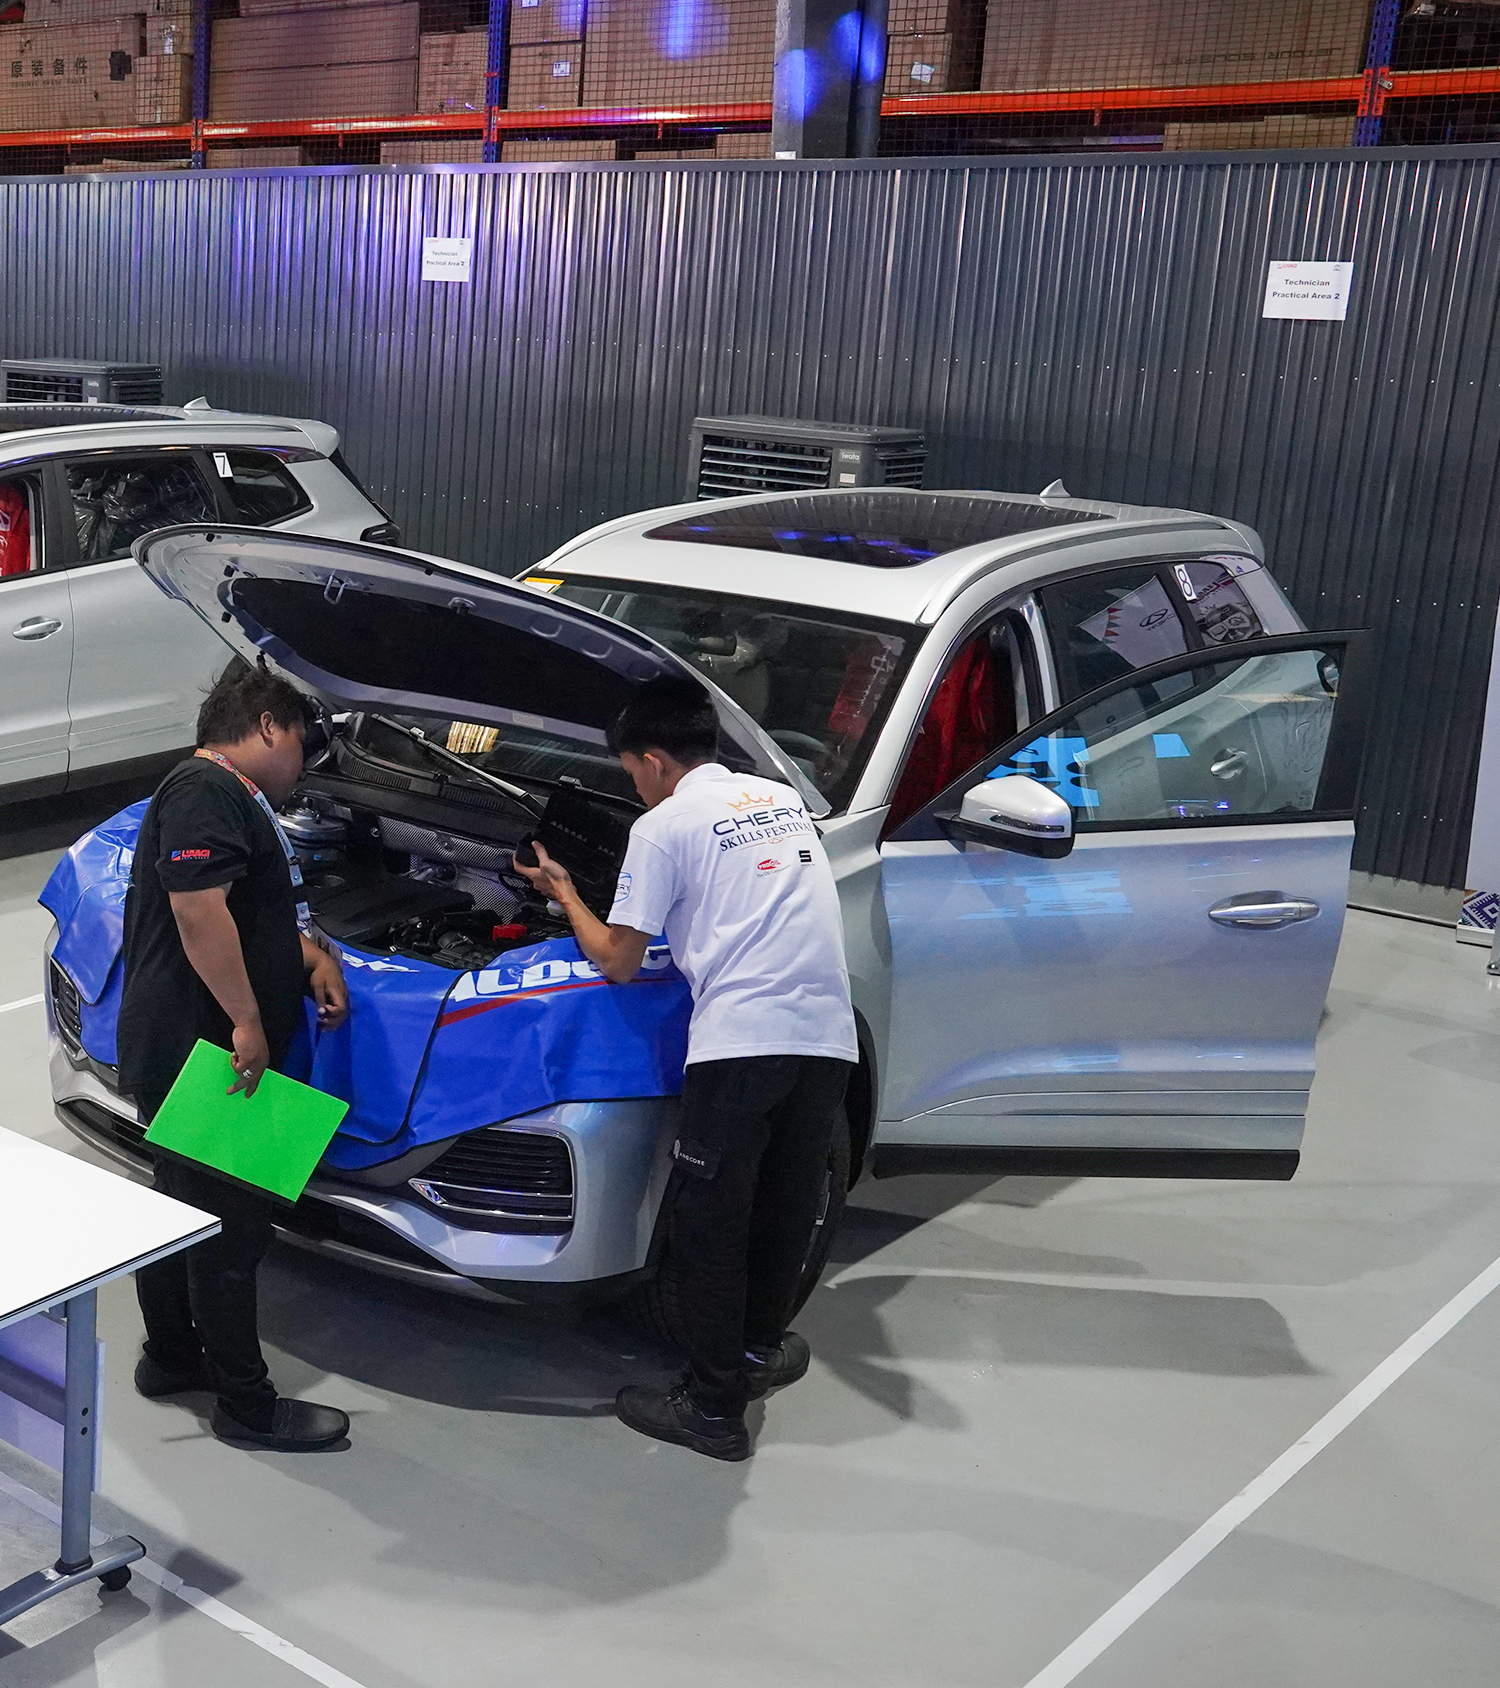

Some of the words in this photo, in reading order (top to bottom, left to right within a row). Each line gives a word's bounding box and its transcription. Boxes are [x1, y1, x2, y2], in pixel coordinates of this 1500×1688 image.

[11, 57, 87, 78] 原装备件
[1272, 291, 1309, 299] Practical
[1334, 292, 1340, 300] 2
[214, 455, 225, 475] 7
[1176, 567, 1193, 597] 8
[713, 807, 803, 836] CHERY
[720, 830, 764, 852] SKILLS
[764, 822, 813, 838] FESTIVAL
